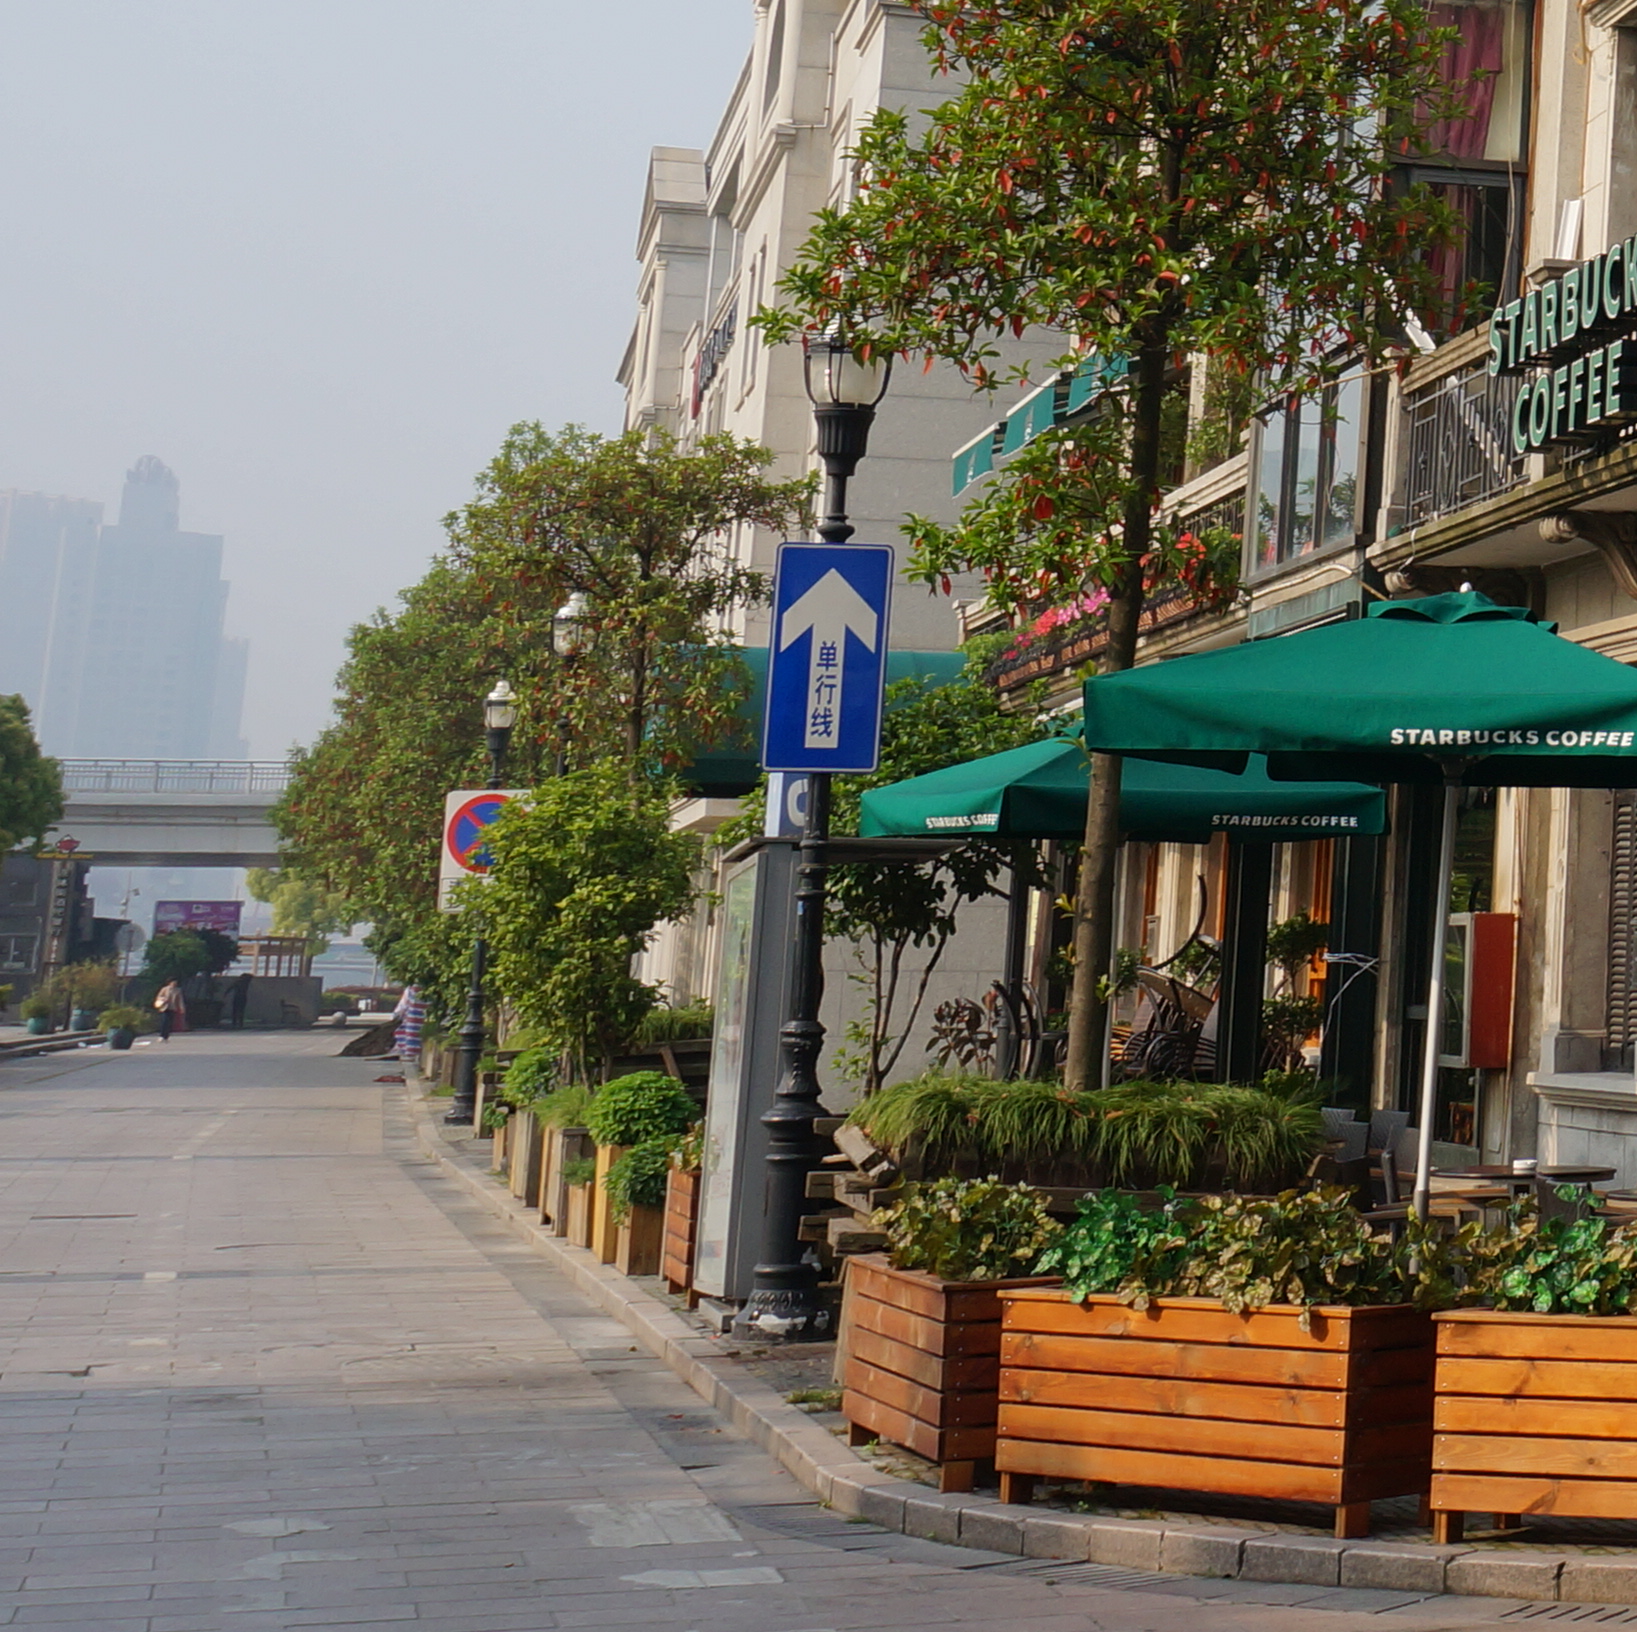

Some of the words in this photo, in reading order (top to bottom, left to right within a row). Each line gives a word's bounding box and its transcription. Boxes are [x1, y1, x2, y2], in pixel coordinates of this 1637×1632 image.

[1512, 339, 1623, 454] COFFEE
[810, 641, 838, 738] 单行线
[1390, 728, 1539, 746] STARBUCKS
[1545, 730, 1635, 747] COFFEE
[1211, 815, 1298, 827] STARBUCKS
[1301, 816, 1358, 828] COFFEE
